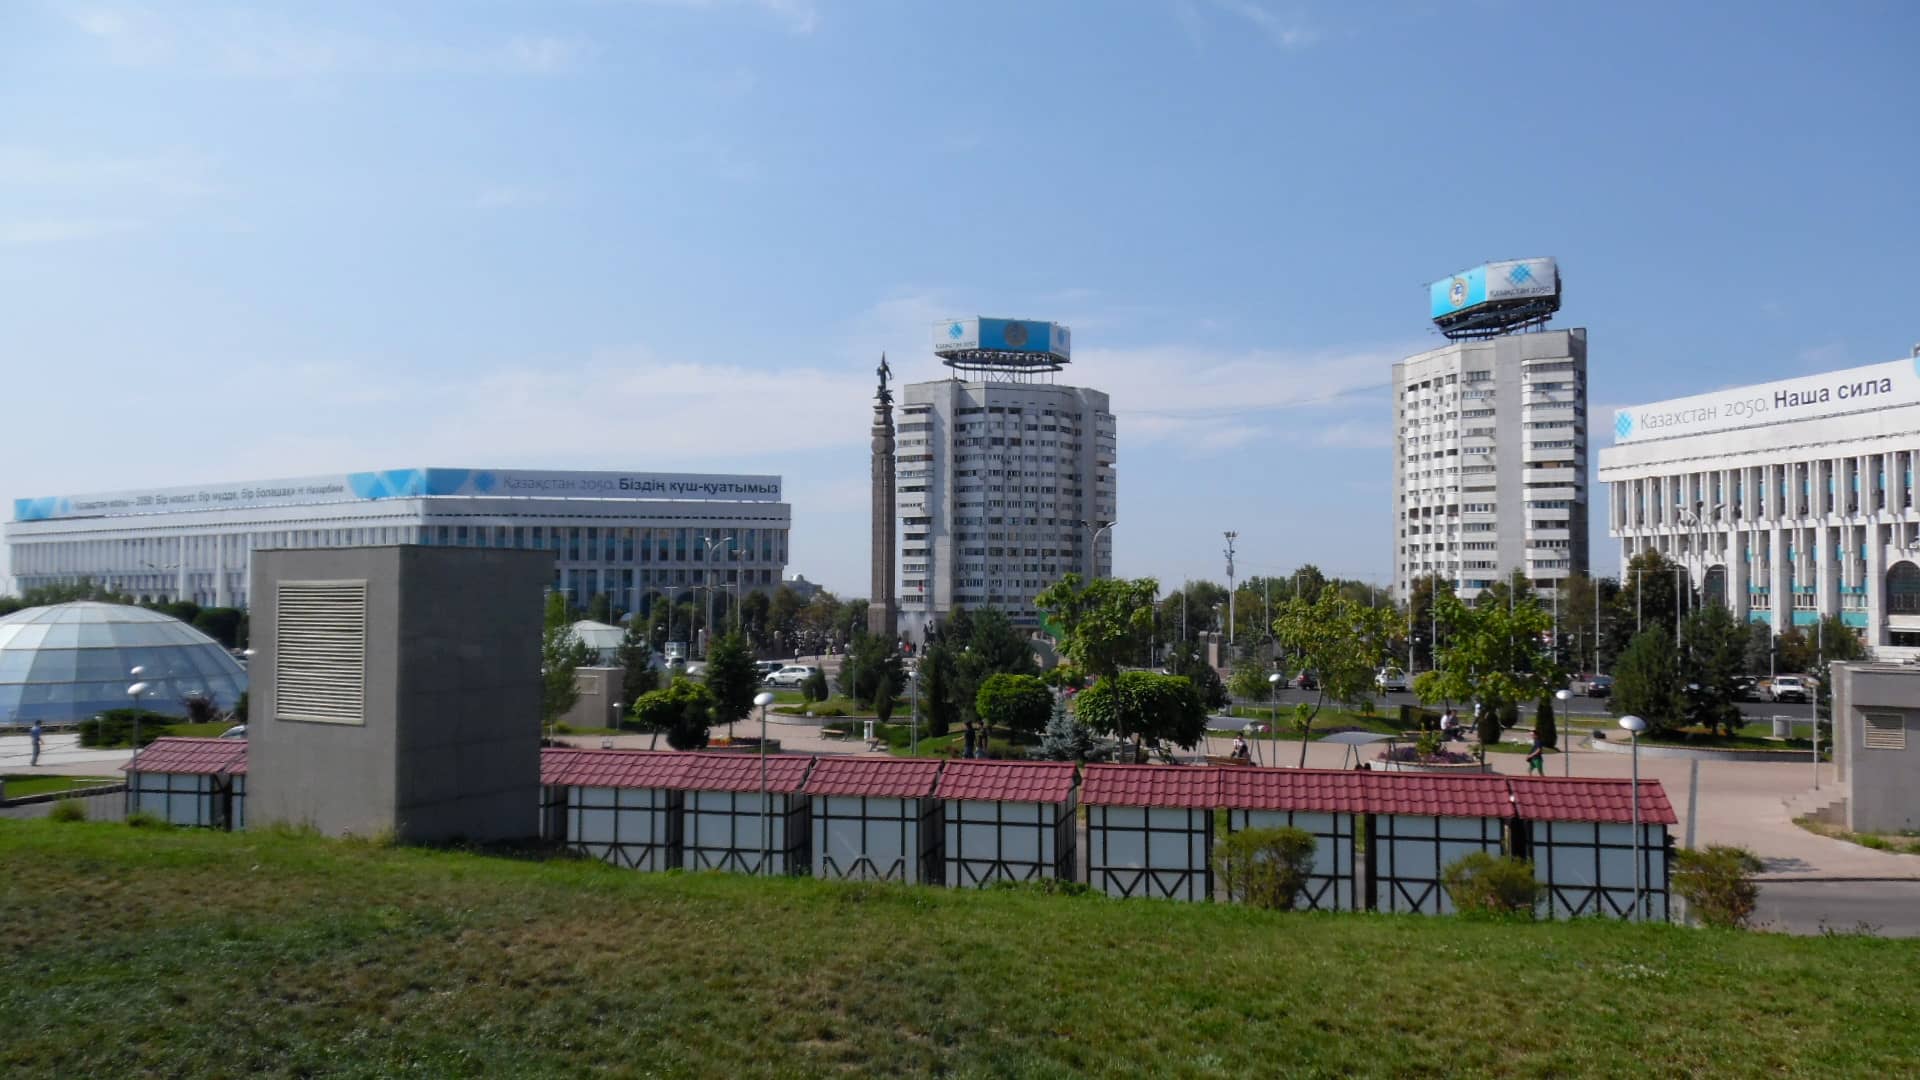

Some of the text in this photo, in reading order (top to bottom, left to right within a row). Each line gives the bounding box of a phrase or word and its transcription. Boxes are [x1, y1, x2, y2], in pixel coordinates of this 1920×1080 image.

[1640, 377, 1892, 430] Казахстан 2050. Наша сила
[503, 476, 575, 491] Қазақстан
[619, 478, 665, 492] Біздің
[669, 480, 778, 495] күш-қуатымыз
